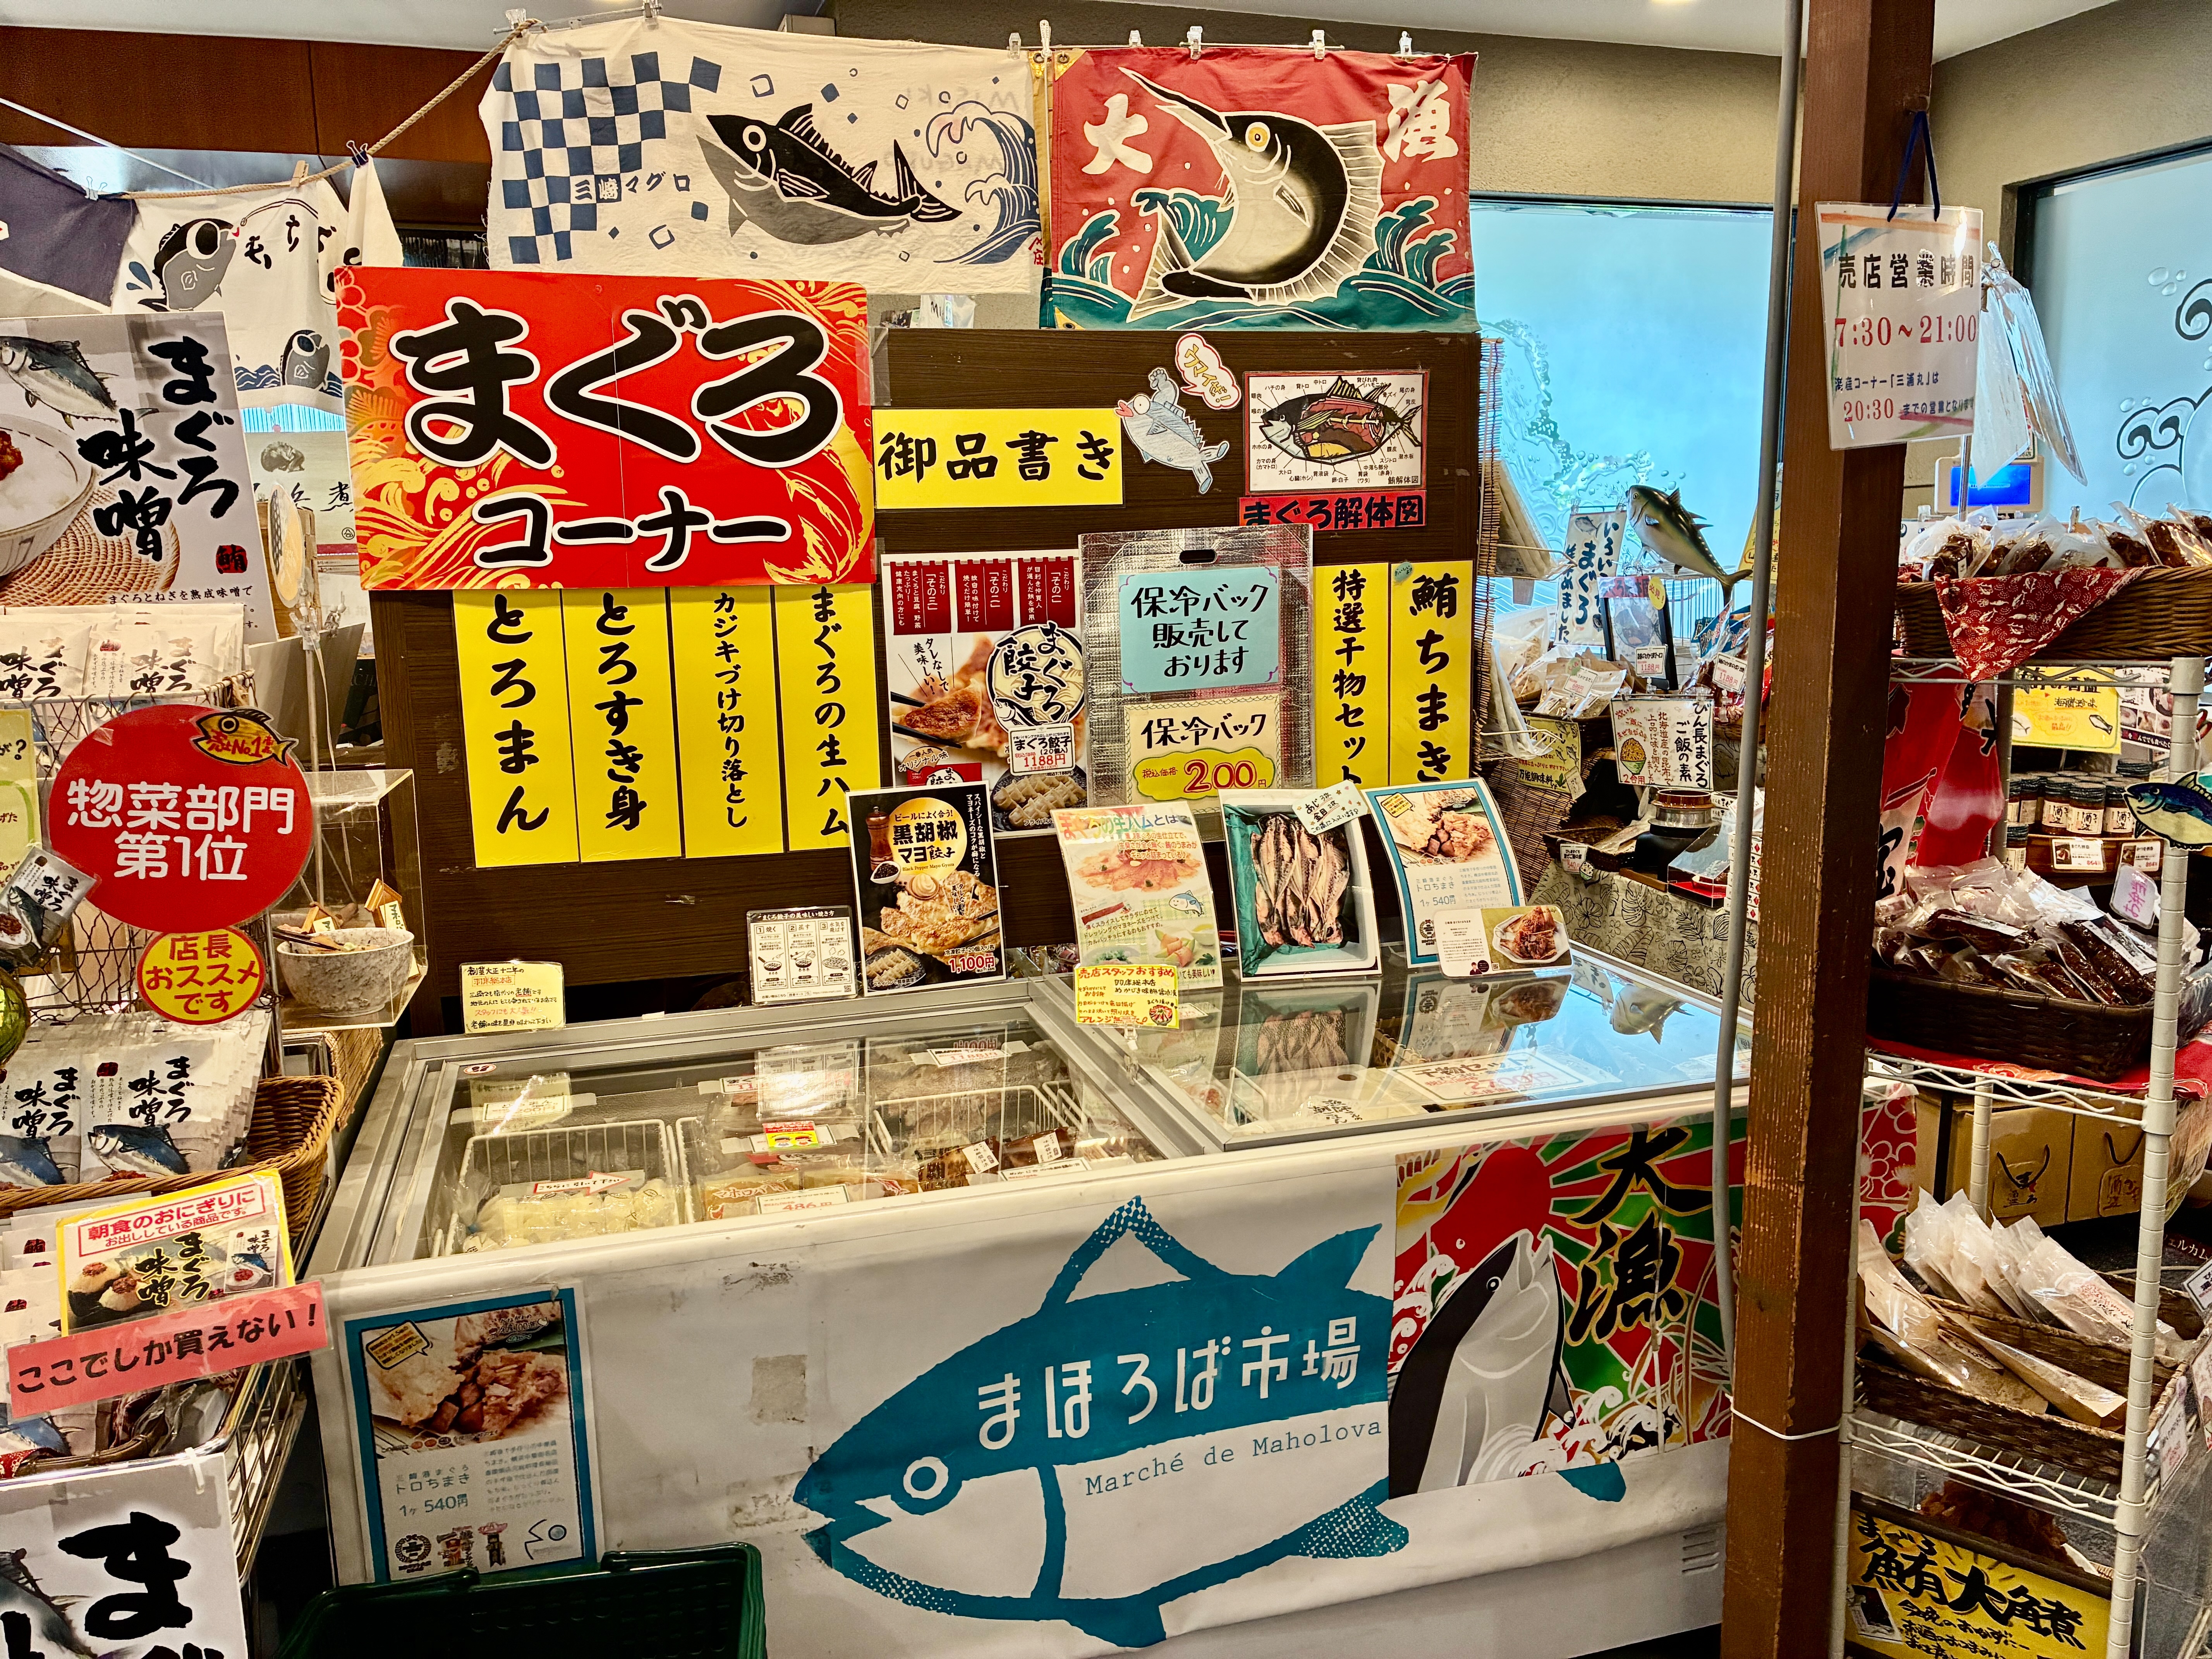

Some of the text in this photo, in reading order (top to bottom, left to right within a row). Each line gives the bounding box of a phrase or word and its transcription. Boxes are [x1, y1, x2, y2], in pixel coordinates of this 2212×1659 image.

[1082, 79, 1457, 175] 大 漁
[1838, 249, 1974, 289] 売店営業時間
[391, 296, 842, 467] まぐろ
[148, 336, 239, 519] まぐろ
[1844, 398, 1893, 421] 20:30
[878, 430, 1114, 483] 御品書き
[1388, 476, 1419, 484] 鮪解体図
[77, 409, 177, 562] 味噌
[475, 488, 789, 570] コーナー
[1243, 496, 1422, 529] まぐろ解体図
[108, 586, 252, 605] まぐろとねぎを熟成味噌で
[895, 571, 905, 626] 健康志向の方にも
[912, 570, 921, 629] まぐろと豆腐、野菜
[926, 573, 938, 610] 「その三」
[989, 571, 1001, 608] 「その二」
[1132, 584, 1269, 618] 保冷バック
[1575, 540, 1597, 625] まぐろ
[1152, 618, 1248, 649] 販売して
[0, 646, 38, 697] 味噌
[33, 637, 67, 697] まぐろ
[130, 649, 168, 693] 味噌
[165, 637, 196, 691] まぐろ
[925, 637, 949, 692] タレなしで
[996, 636, 1044, 702] 餃子
[1038, 621, 1072, 721] まぐろ
[1164, 646, 1249, 678] おります
[1333, 569, 1366, 785] 特選干物セット
[1409, 573, 1459, 783] 鮪ちまき
[486, 593, 549, 834] とろまん
[594, 592, 647, 831] とろすき身
[713, 592, 749, 828] カジキづけ切り落とし
[811, 586, 849, 836] まぐろの生ハム
[1141, 713, 1267, 749] 保冷バック
[1615, 706, 1635, 720] 炊いた
[1625, 718, 1643, 727] ご飯に
[898, 751, 948, 772] オリジナル味
[1014, 736, 1072, 751] まぐろ餃子
[1024, 754, 1066, 768] 1188円
[1658, 711, 1674, 786] 北海道産の昆布で
[1674, 720, 1693, 782] ご飯の素
[1693, 702, 1711, 788] びん長まぐろ
[1142, 759, 1267, 793] 税込価格 200円
[1519, 769, 1554, 785] 万能調味料
[1623, 774, 1645, 785] 2合用
[1647, 760, 1656, 785] ました
[67, 779, 294, 835] 惣菜部門
[974, 793, 986, 859] スパイシーな黒胡椒と
[1305, 798, 1320, 814] あじ
[114, 831, 248, 881] 第1位
[893, 820, 958, 845] 黒胡椒
[898, 845, 955, 863] マヨ餃子
[966, 794, 980, 877] マヨネーズのコクが癖になる
[48, 876, 79, 912] まぐろ
[1417, 881, 1455, 892] トロちまき
[1433, 895, 1456, 906] 540円
[762, 910, 835, 921] まぐろ餃子の美味しい焼き方
[169, 934, 232, 961] 店長
[949, 955, 995, 974] 1,100円
[145, 959, 259, 991] おススメ
[1079, 967, 1175, 979] 売店スタッフおすすめ
[174, 989, 233, 1013] です
[12, 1080, 52, 1139] 味噌
[46, 1066, 81, 1136] まぐろ
[128, 1070, 167, 1127] 味噌
[164, 1056, 195, 1122] まぐろ
[88, 1188, 256, 1241] 朝食のおにぎりに
[105, 1207, 247, 1247] お出ししている商品です。
[1567, 1126, 1713, 1345] 大漁
[134, 1247, 179, 1307] 味噌
[173, 1231, 211, 1301] まぐろ
[977, 1316, 1361, 1450] まほろば市場
[1085, 1416, 1384, 1496] Marché de Maholova
[396, 1473, 470, 1494] トロちまき
[424, 1494, 468, 1513] 540円
